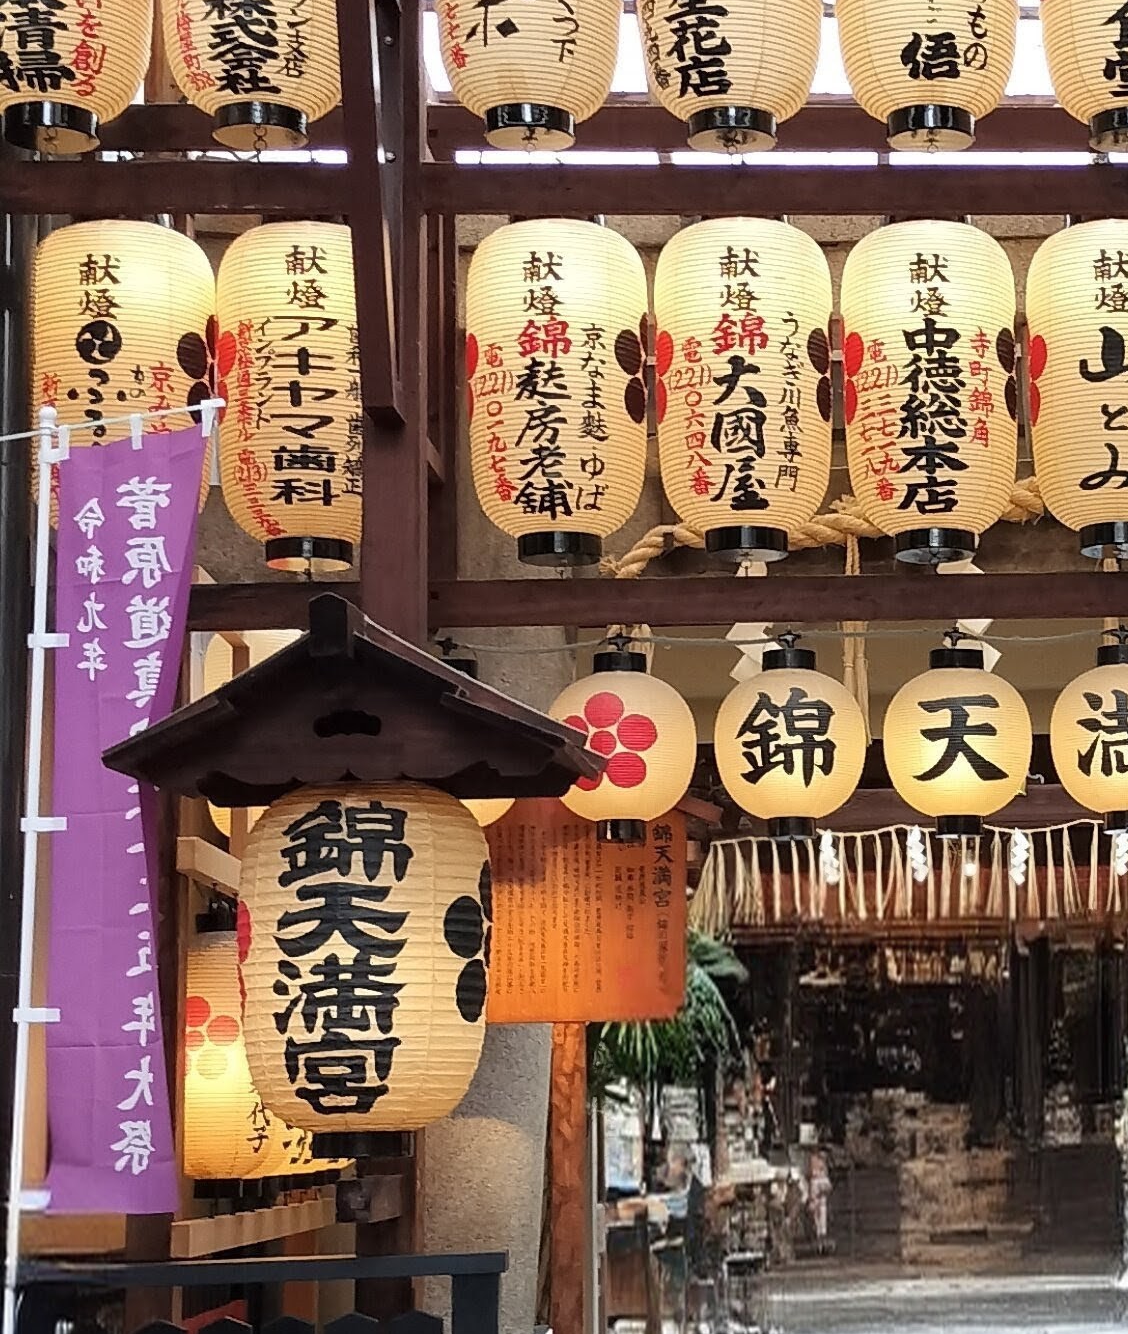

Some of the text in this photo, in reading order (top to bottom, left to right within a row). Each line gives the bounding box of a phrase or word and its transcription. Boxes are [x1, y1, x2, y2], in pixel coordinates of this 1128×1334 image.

[79, 254, 122, 320] 献燈
[285, 246, 329, 310] 献燈
[523, 251, 564, 316] 献燈
[719, 245, 761, 312] 献燈
[909, 253, 950, 318] 献燈
[516, 317, 573, 359] 錦
[271, 315, 340, 506] アキヤマ歯科
[710, 312, 770, 510] 錦 大國屋
[896, 317, 969, 515] 中徳総本店
[737, 688, 837, 787] 錦
[912, 694, 1009, 781] 天
[652, 823, 674, 908] 錦天満宮
[273, 800, 414, 1115] 錦天満宮
